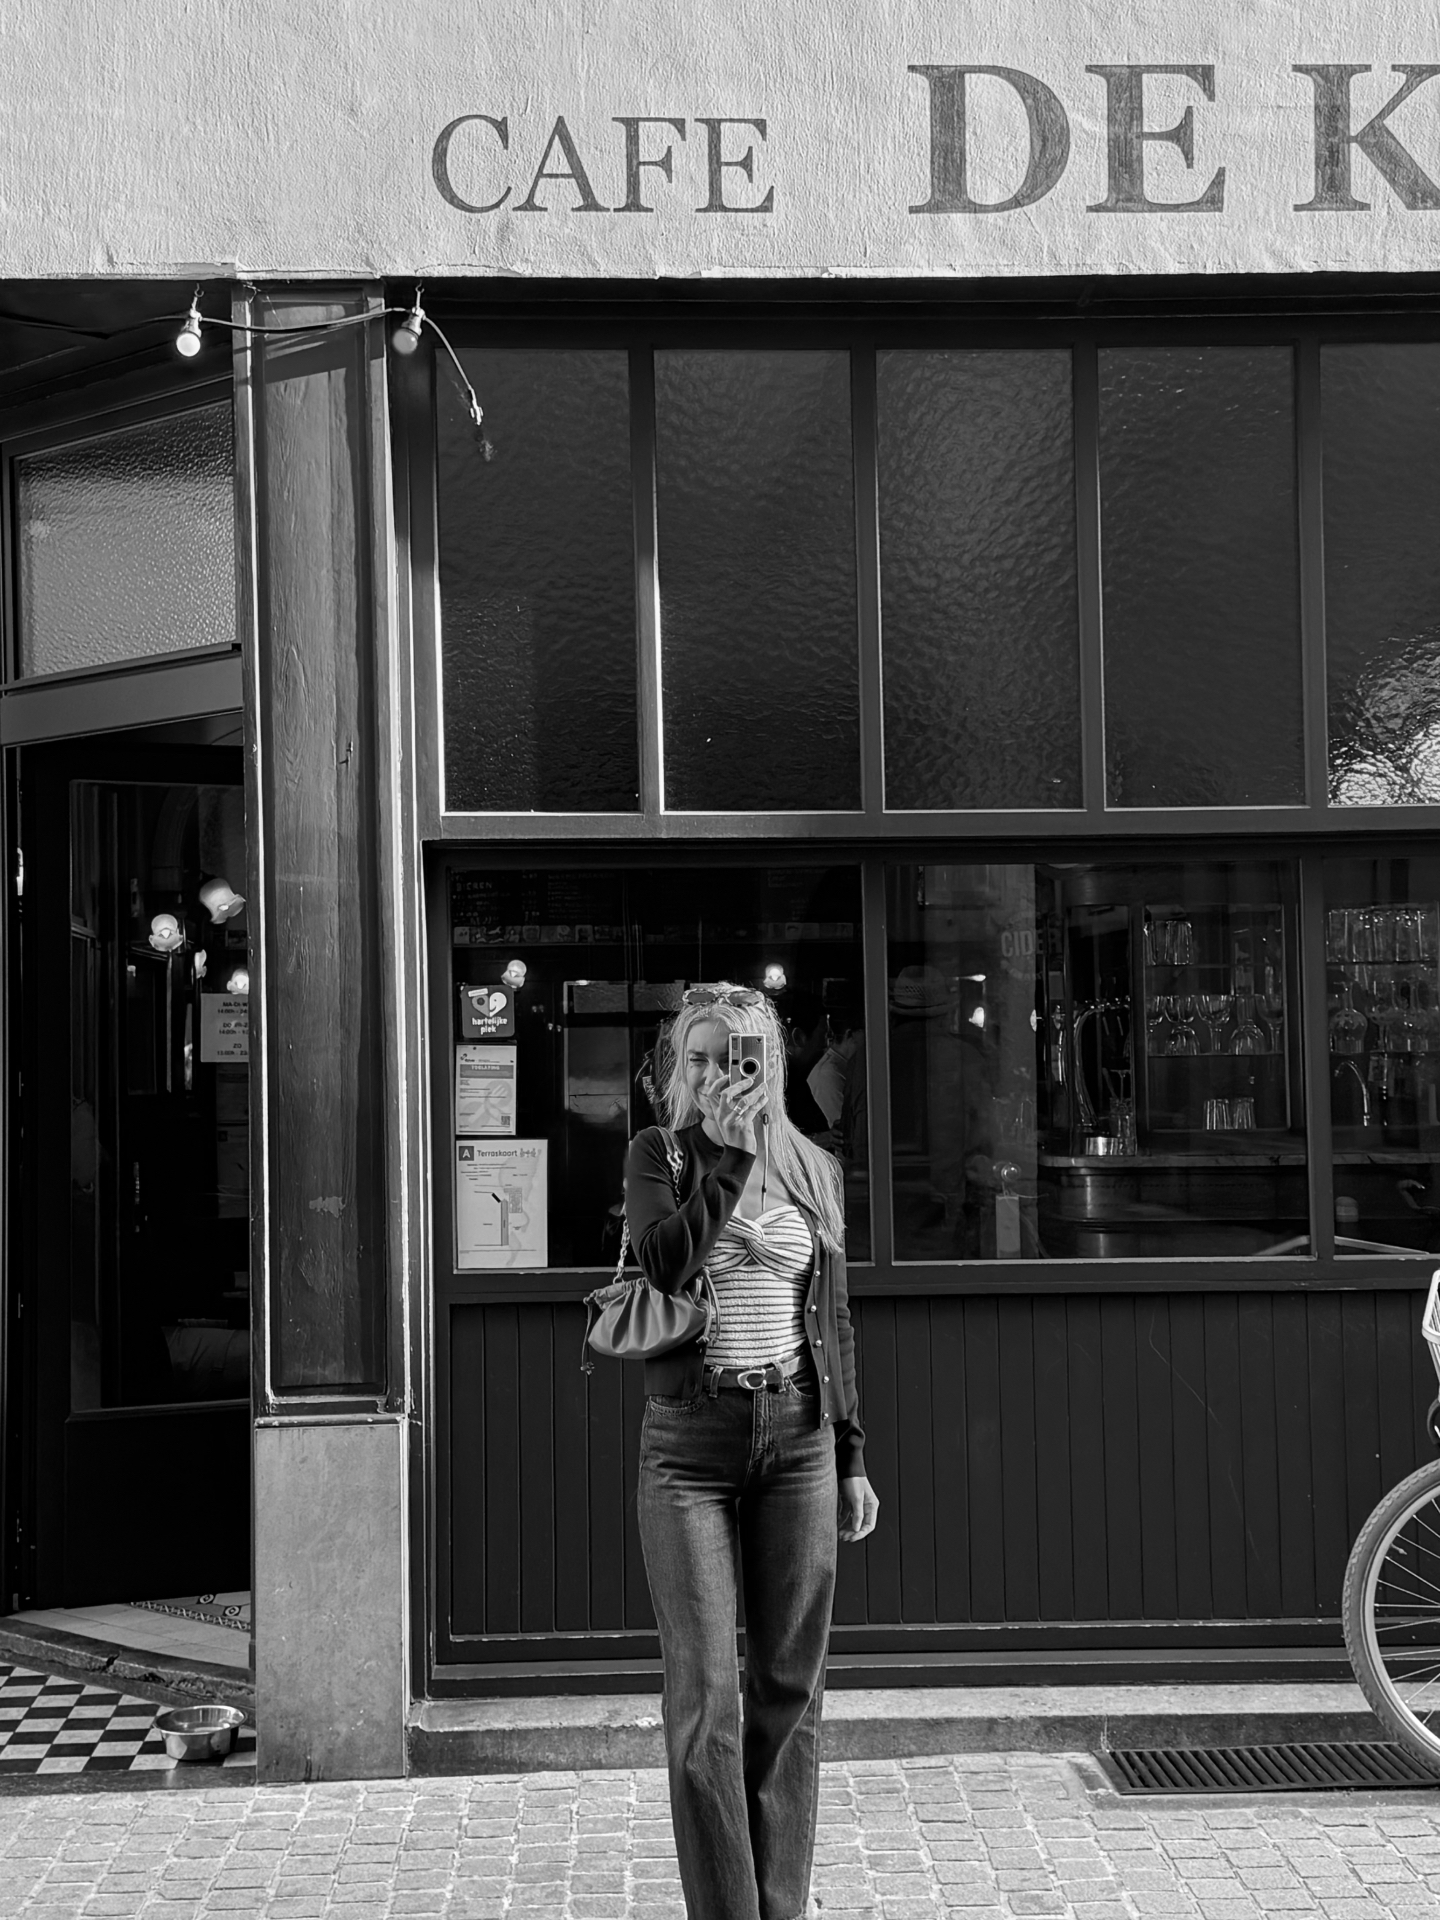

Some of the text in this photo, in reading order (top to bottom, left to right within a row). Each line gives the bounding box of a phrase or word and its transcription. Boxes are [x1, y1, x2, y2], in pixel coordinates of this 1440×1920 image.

[432, 64, 1440, 213] CAFE DE K
[471, 1016, 508, 1027] hartelijke
[480, 1024, 497, 1036] plek
[477, 1149, 518, 1158] Terraskaart
